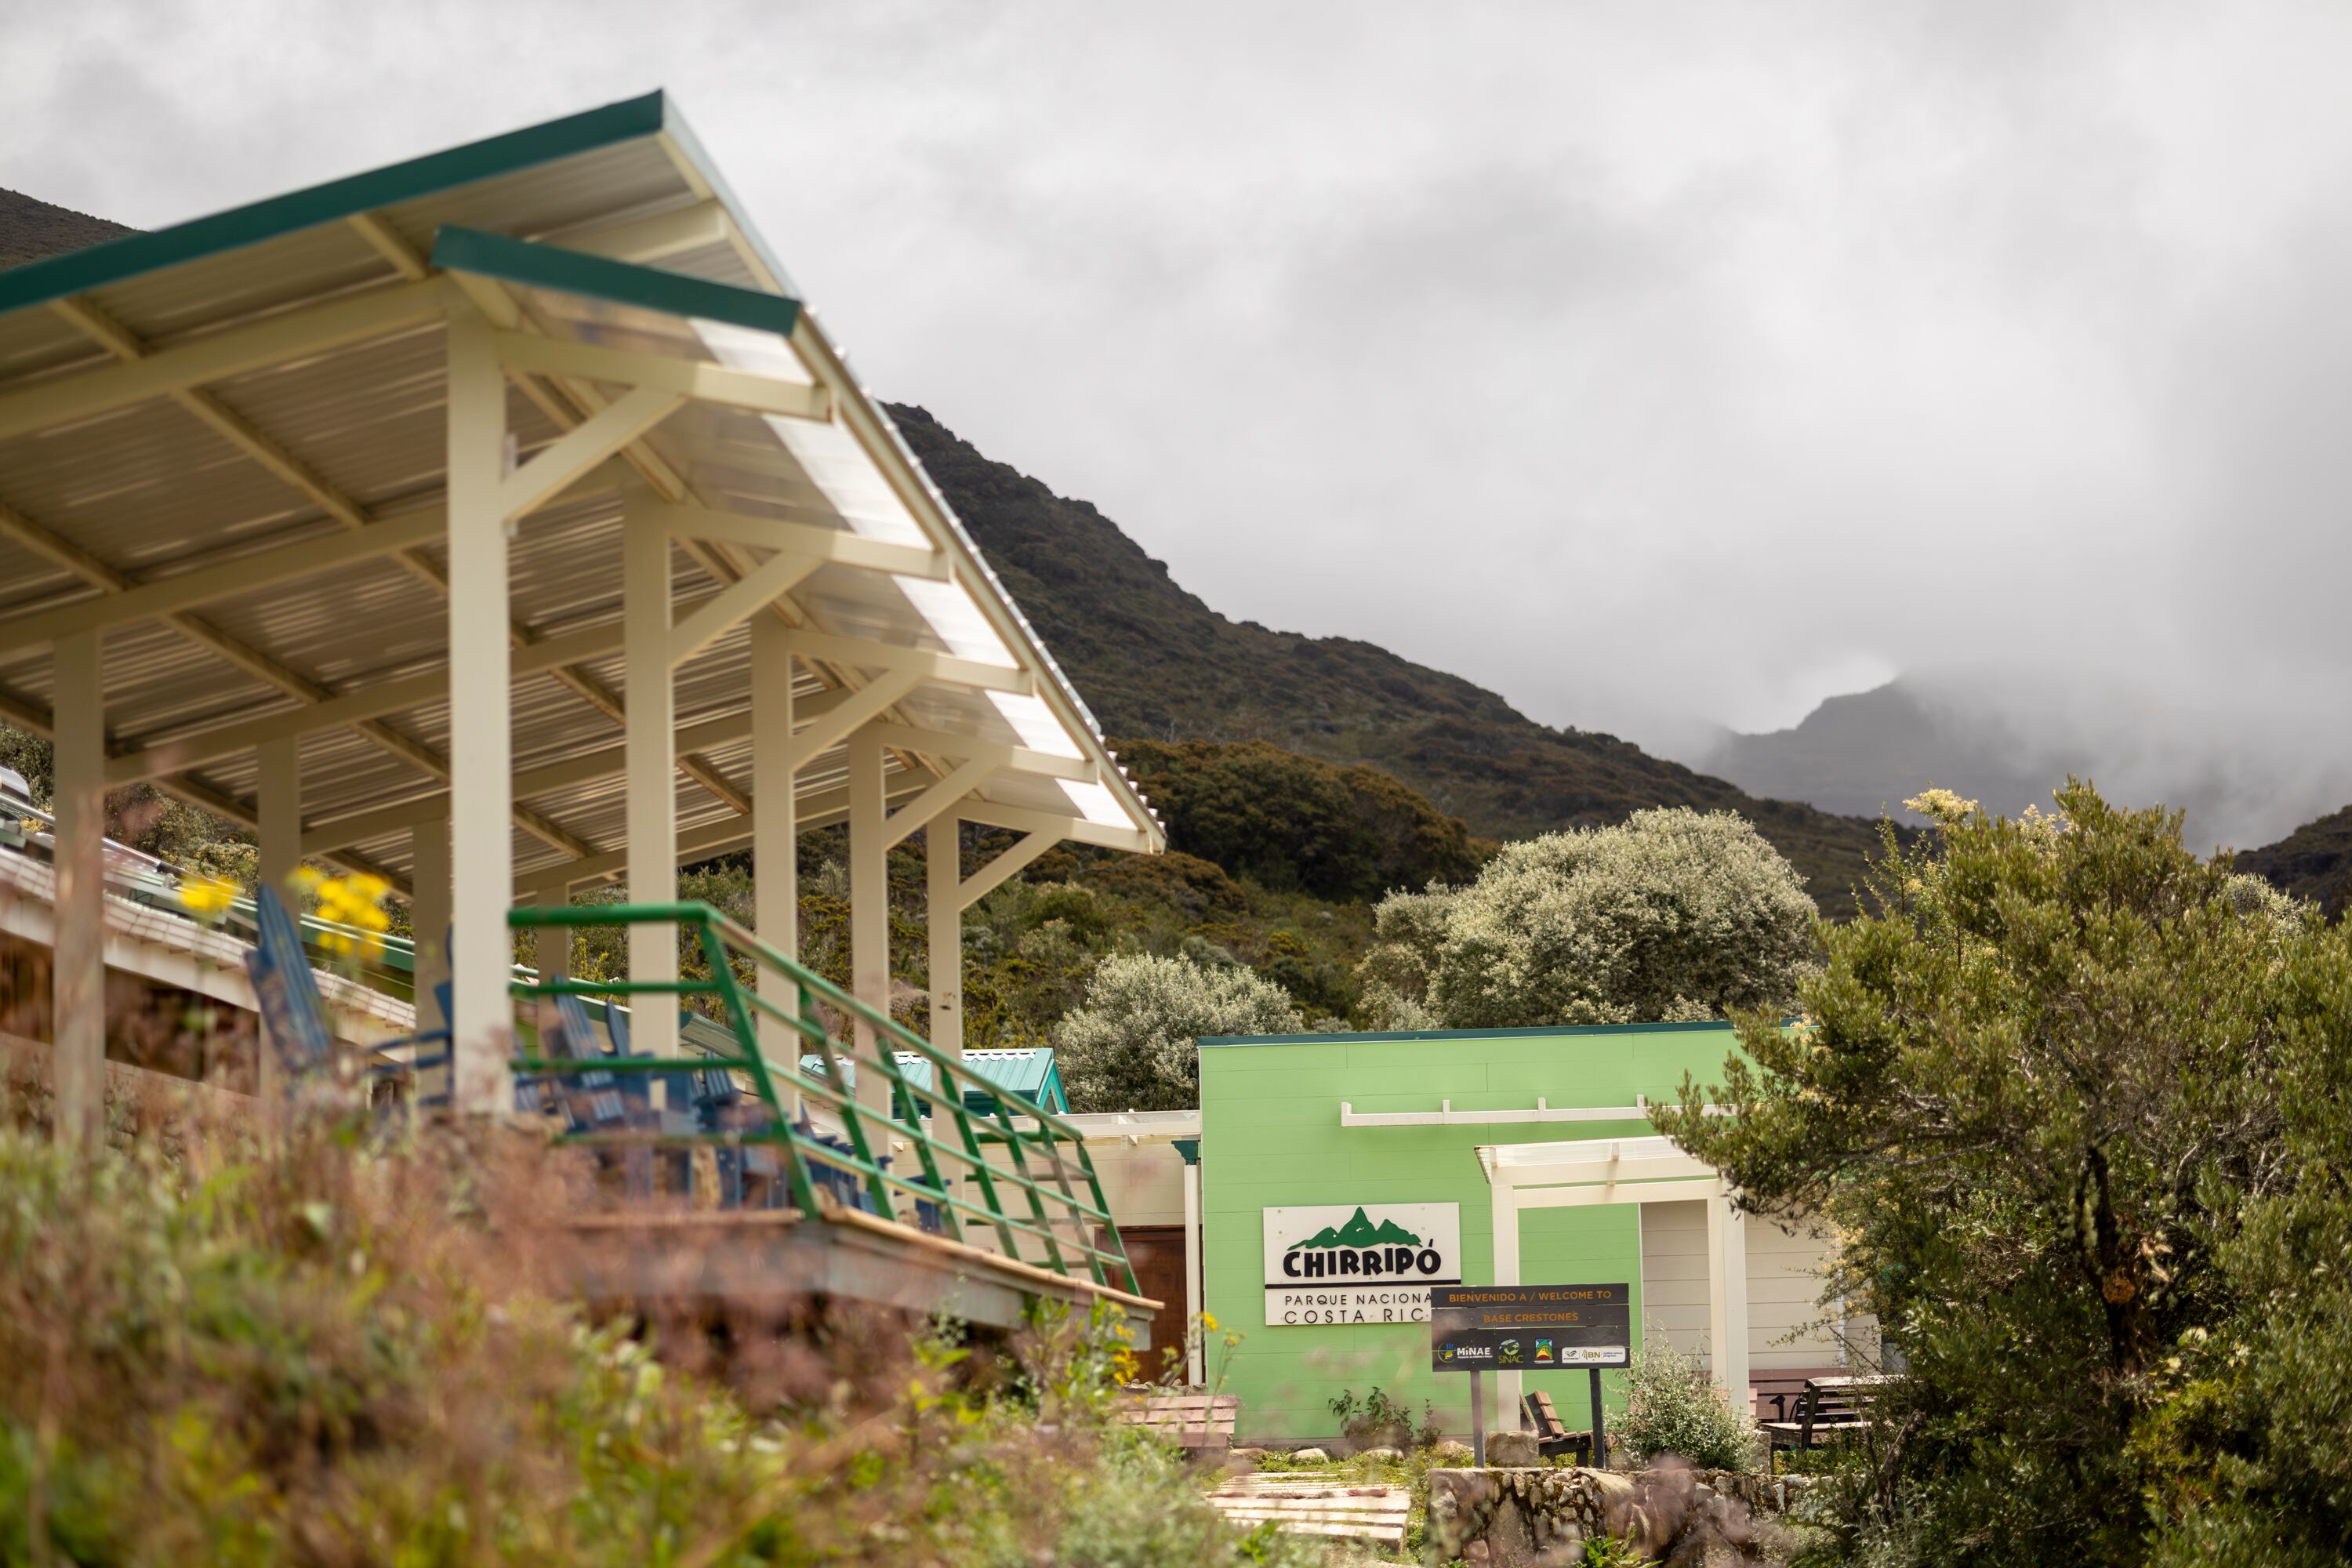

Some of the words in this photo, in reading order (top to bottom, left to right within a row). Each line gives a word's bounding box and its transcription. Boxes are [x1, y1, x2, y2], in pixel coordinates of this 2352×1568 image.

[1283, 1239, 1441, 1277] CHIRRIPÓ
[1285, 1294, 1347, 1305] PARQUE
[1356, 1293, 1431, 1305] NACIONA
[1449, 1293, 1515, 1302] BIENVENIDO
[1530, 1292, 1535, 1302] /
[1538, 1291, 1593, 1301] WELCOME
[1596, 1290, 1612, 1299] TO
[1284, 1309, 1365, 1324] COSTA
[1383, 1308, 1424, 1322] RIC
[1483, 1313, 1512, 1323] BASE
[1515, 1312, 1578, 1323] CRESTONES
[1498, 1355, 1524, 1363] SINAC
